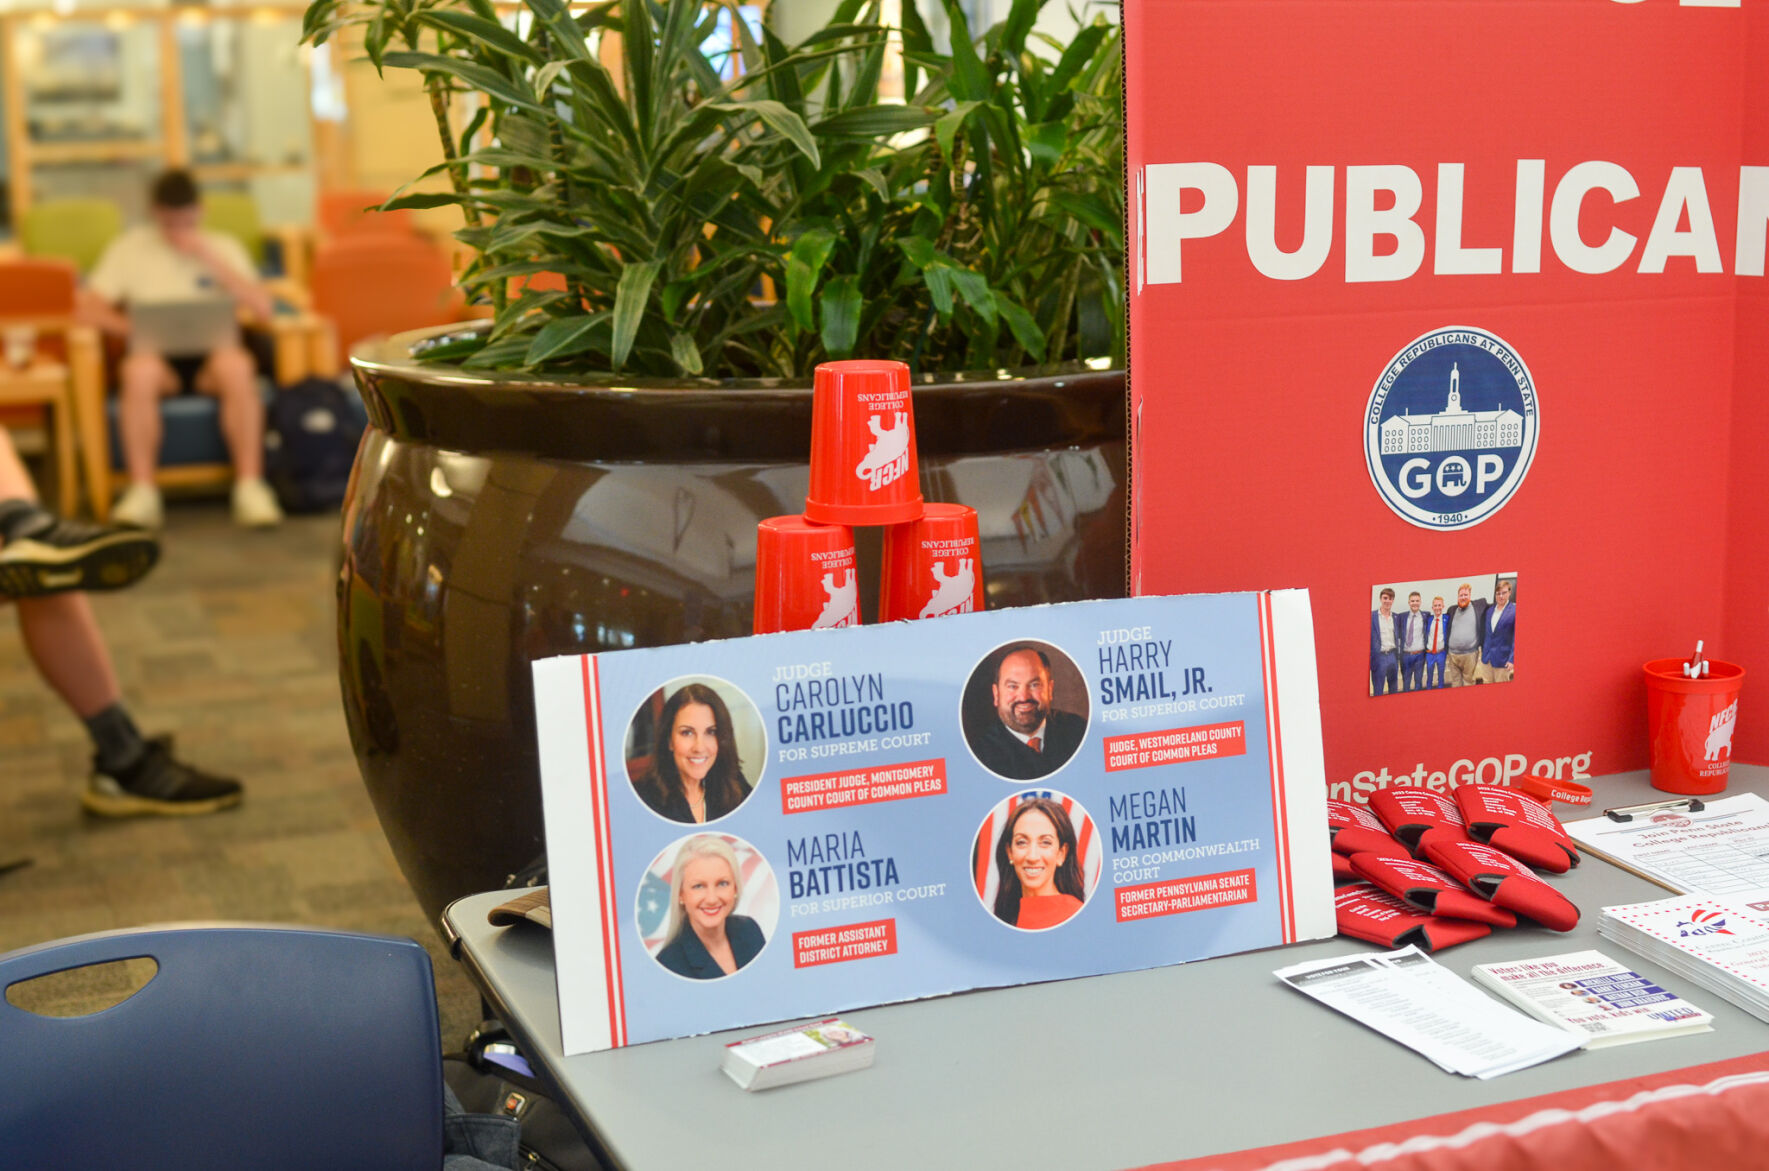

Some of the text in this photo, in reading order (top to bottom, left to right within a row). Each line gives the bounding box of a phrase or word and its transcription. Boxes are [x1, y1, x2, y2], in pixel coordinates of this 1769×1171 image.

[1371, 334, 1534, 425] COLLEGE REPUBLICANS AT PENN STATE
[868, 400, 904, 411] COLLEGE
[869, 446, 909, 492] NFCR
[1398, 454, 1504, 499] GOP
[1437, 513, 1463, 524] 1940
[932, 547, 969, 558] COLLEGE
[1097, 626, 1152, 645] JUDGE
[772, 662, 832, 682] JUDGE
[1098, 639, 1172, 675] HARRY
[776, 673, 884, 713] CAROLYN
[1100, 667, 1213, 705] SMAIL, JR.
[778, 701, 914, 744] CARLUCCIO
[1101, 694, 1245, 723] FOR SUPERIOR COURT
[778, 732, 931, 762] FOR SUPREME COURT
[1109, 726, 1242, 753] JUDGE, WESTMORELAND COUNTY
[1110, 743, 1217, 767] COURT OF COMMON PLEAS
[786, 765, 934, 795] PRESIDENT JUDGE, MONTGOMERY
[788, 778, 942, 810] COUNTY COURT OF COMMON PLEAS
[1109, 786, 1187, 823] MEGAN
[1551, 789, 1580, 803] College
[787, 830, 865, 868] MARIA
[1111, 815, 1197, 853] MARTIN
[1112, 838, 1260, 870] FOR COMMONWEALTH
[789, 857, 900, 899] BATTISTA
[1113, 866, 1160, 884] COURT
[1120, 874, 1250, 904] FORMER PENNSYLVANIA SENATE
[790, 883, 946, 918] FOR SUPERIOR COURT
[1121, 888, 1248, 918] SECRETARY-PARLIAMENTARIAN
[798, 925, 887, 949] FORMER ASSISTANT
[799, 939, 888, 964] DISTRICT ATTORNEY
